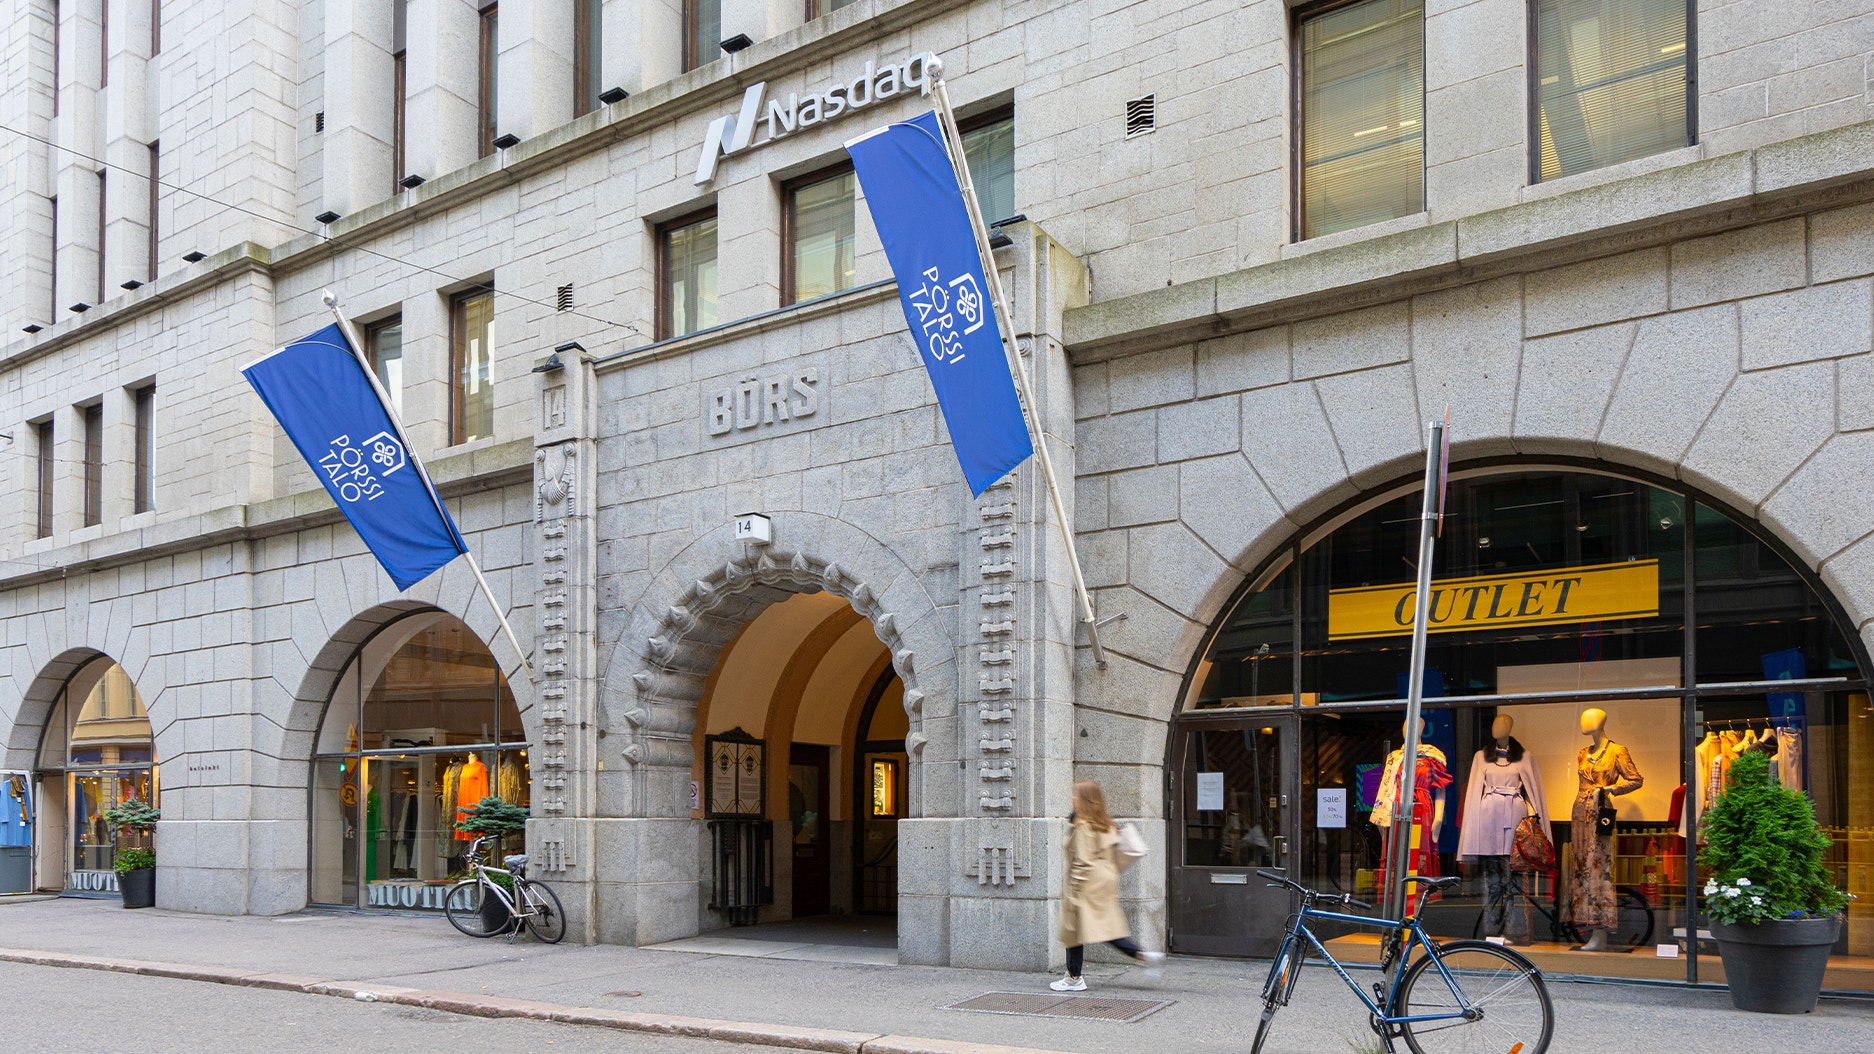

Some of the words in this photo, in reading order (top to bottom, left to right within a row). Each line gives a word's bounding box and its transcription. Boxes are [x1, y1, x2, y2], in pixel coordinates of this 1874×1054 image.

[768, 51, 931, 140] Nasdaq
[909, 282, 944, 361] TALO
[922, 265, 966, 365] PÖRSSI
[708, 365, 818, 437] BÖRS
[318, 449, 361, 502] TALO
[330, 434, 385, 501] PÖRSSI
[738, 520, 751, 534] 14
[1394, 577, 1582, 626] OUTLET
